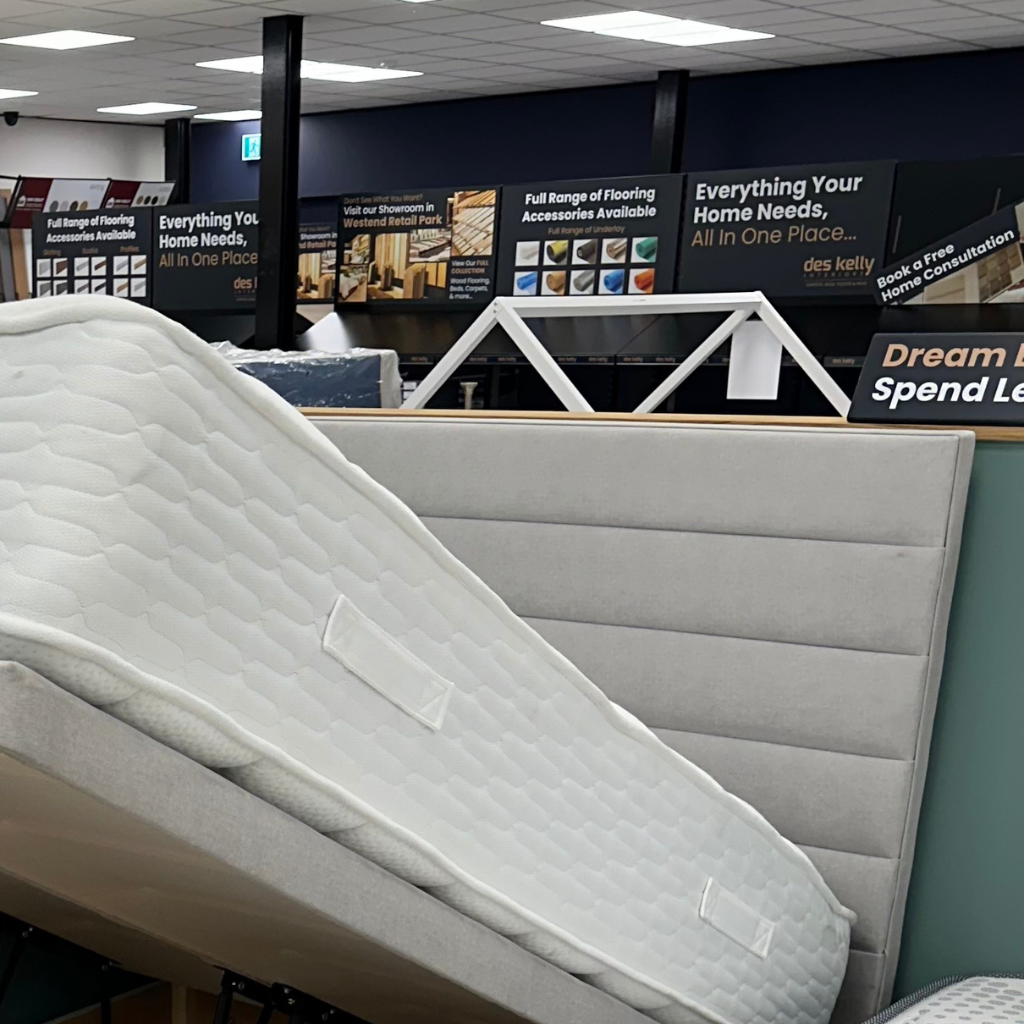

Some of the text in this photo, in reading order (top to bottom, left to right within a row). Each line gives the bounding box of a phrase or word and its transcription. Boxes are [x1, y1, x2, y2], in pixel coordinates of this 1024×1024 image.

[525, 186, 656, 207] Full Range of Flooring
[696, 175, 864, 204] Everything Your
[343, 202, 435, 216] Visit our Showroom in
[522, 205, 657, 223] Accessories Available
[693, 200, 829, 224] Home Needs,
[47, 214, 135, 230] Full Range of Flooring
[159, 211, 259, 233] Everything You
[343, 214, 443, 229] Westend Retail Park
[548, 226, 560, 236] Full
[560, 226, 584, 237] Range
[593, 224, 626, 235] Underlay
[46, 228, 137, 244] Accessories Available
[159, 230, 248, 250] Home Needs,
[691, 224, 857, 248] All In One Place...
[158, 252, 174, 268] All
[176, 252, 188, 267] In
[191, 252, 219, 267] One
[804, 255, 876, 276] des kelly
[876, 242, 956, 290] Book a Free
[880, 228, 1016, 303] Home Consultation
[234, 276, 252, 290] des
[882, 343, 1007, 368] Dream
[871, 376, 1024, 410] Spend Le
